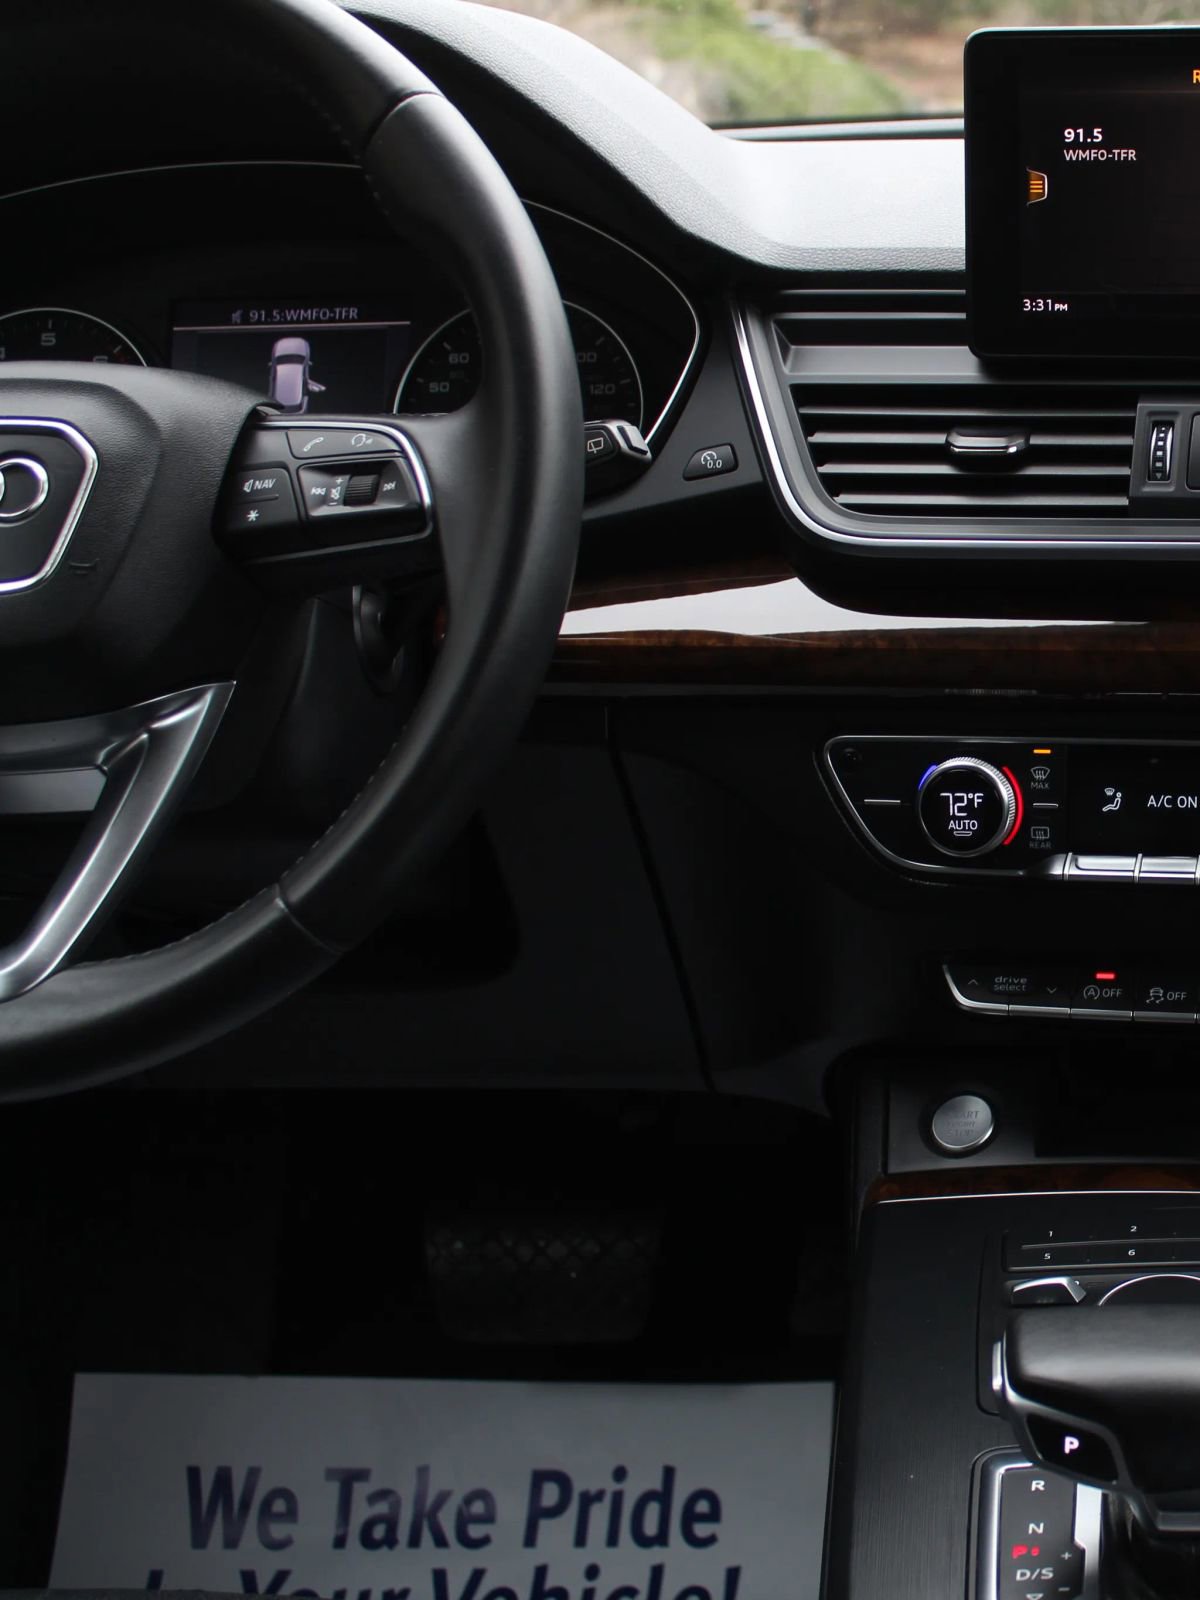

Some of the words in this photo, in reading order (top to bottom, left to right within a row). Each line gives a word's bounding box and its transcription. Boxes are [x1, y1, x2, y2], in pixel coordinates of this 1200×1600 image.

[1063, 127, 1103, 143] 91.5
[1063, 149, 1137, 161] WMFO-TFR
[40, 332, 57, 347] 5
[589, 383, 616, 395] 120
[706, 459, 723, 469] 0.0
[253, 477, 277, 490] NAV
[1030, 781, 1050, 790] MAX
[1147, 794, 1173, 809] A/C
[1177, 795, 1198, 809] ON
[948, 819, 978, 831] AUTO
[994, 975, 1028, 985] drive
[993, 984, 1027, 992] select
[1102, 988, 1123, 999] OFF
[1166, 991, 1187, 1001] OFF
[1043, 1252, 1051, 1260] 5
[1063, 1435, 1080, 1454] P
[1031, 1479, 1046, 1492] R
[184, 1465, 299, 1552] We
[324, 1464, 497, 1551] Take
[522, 1464, 724, 1551] Pride
[1028, 1522, 1045, 1535] N
[1015, 1567, 1054, 1582] D/S
